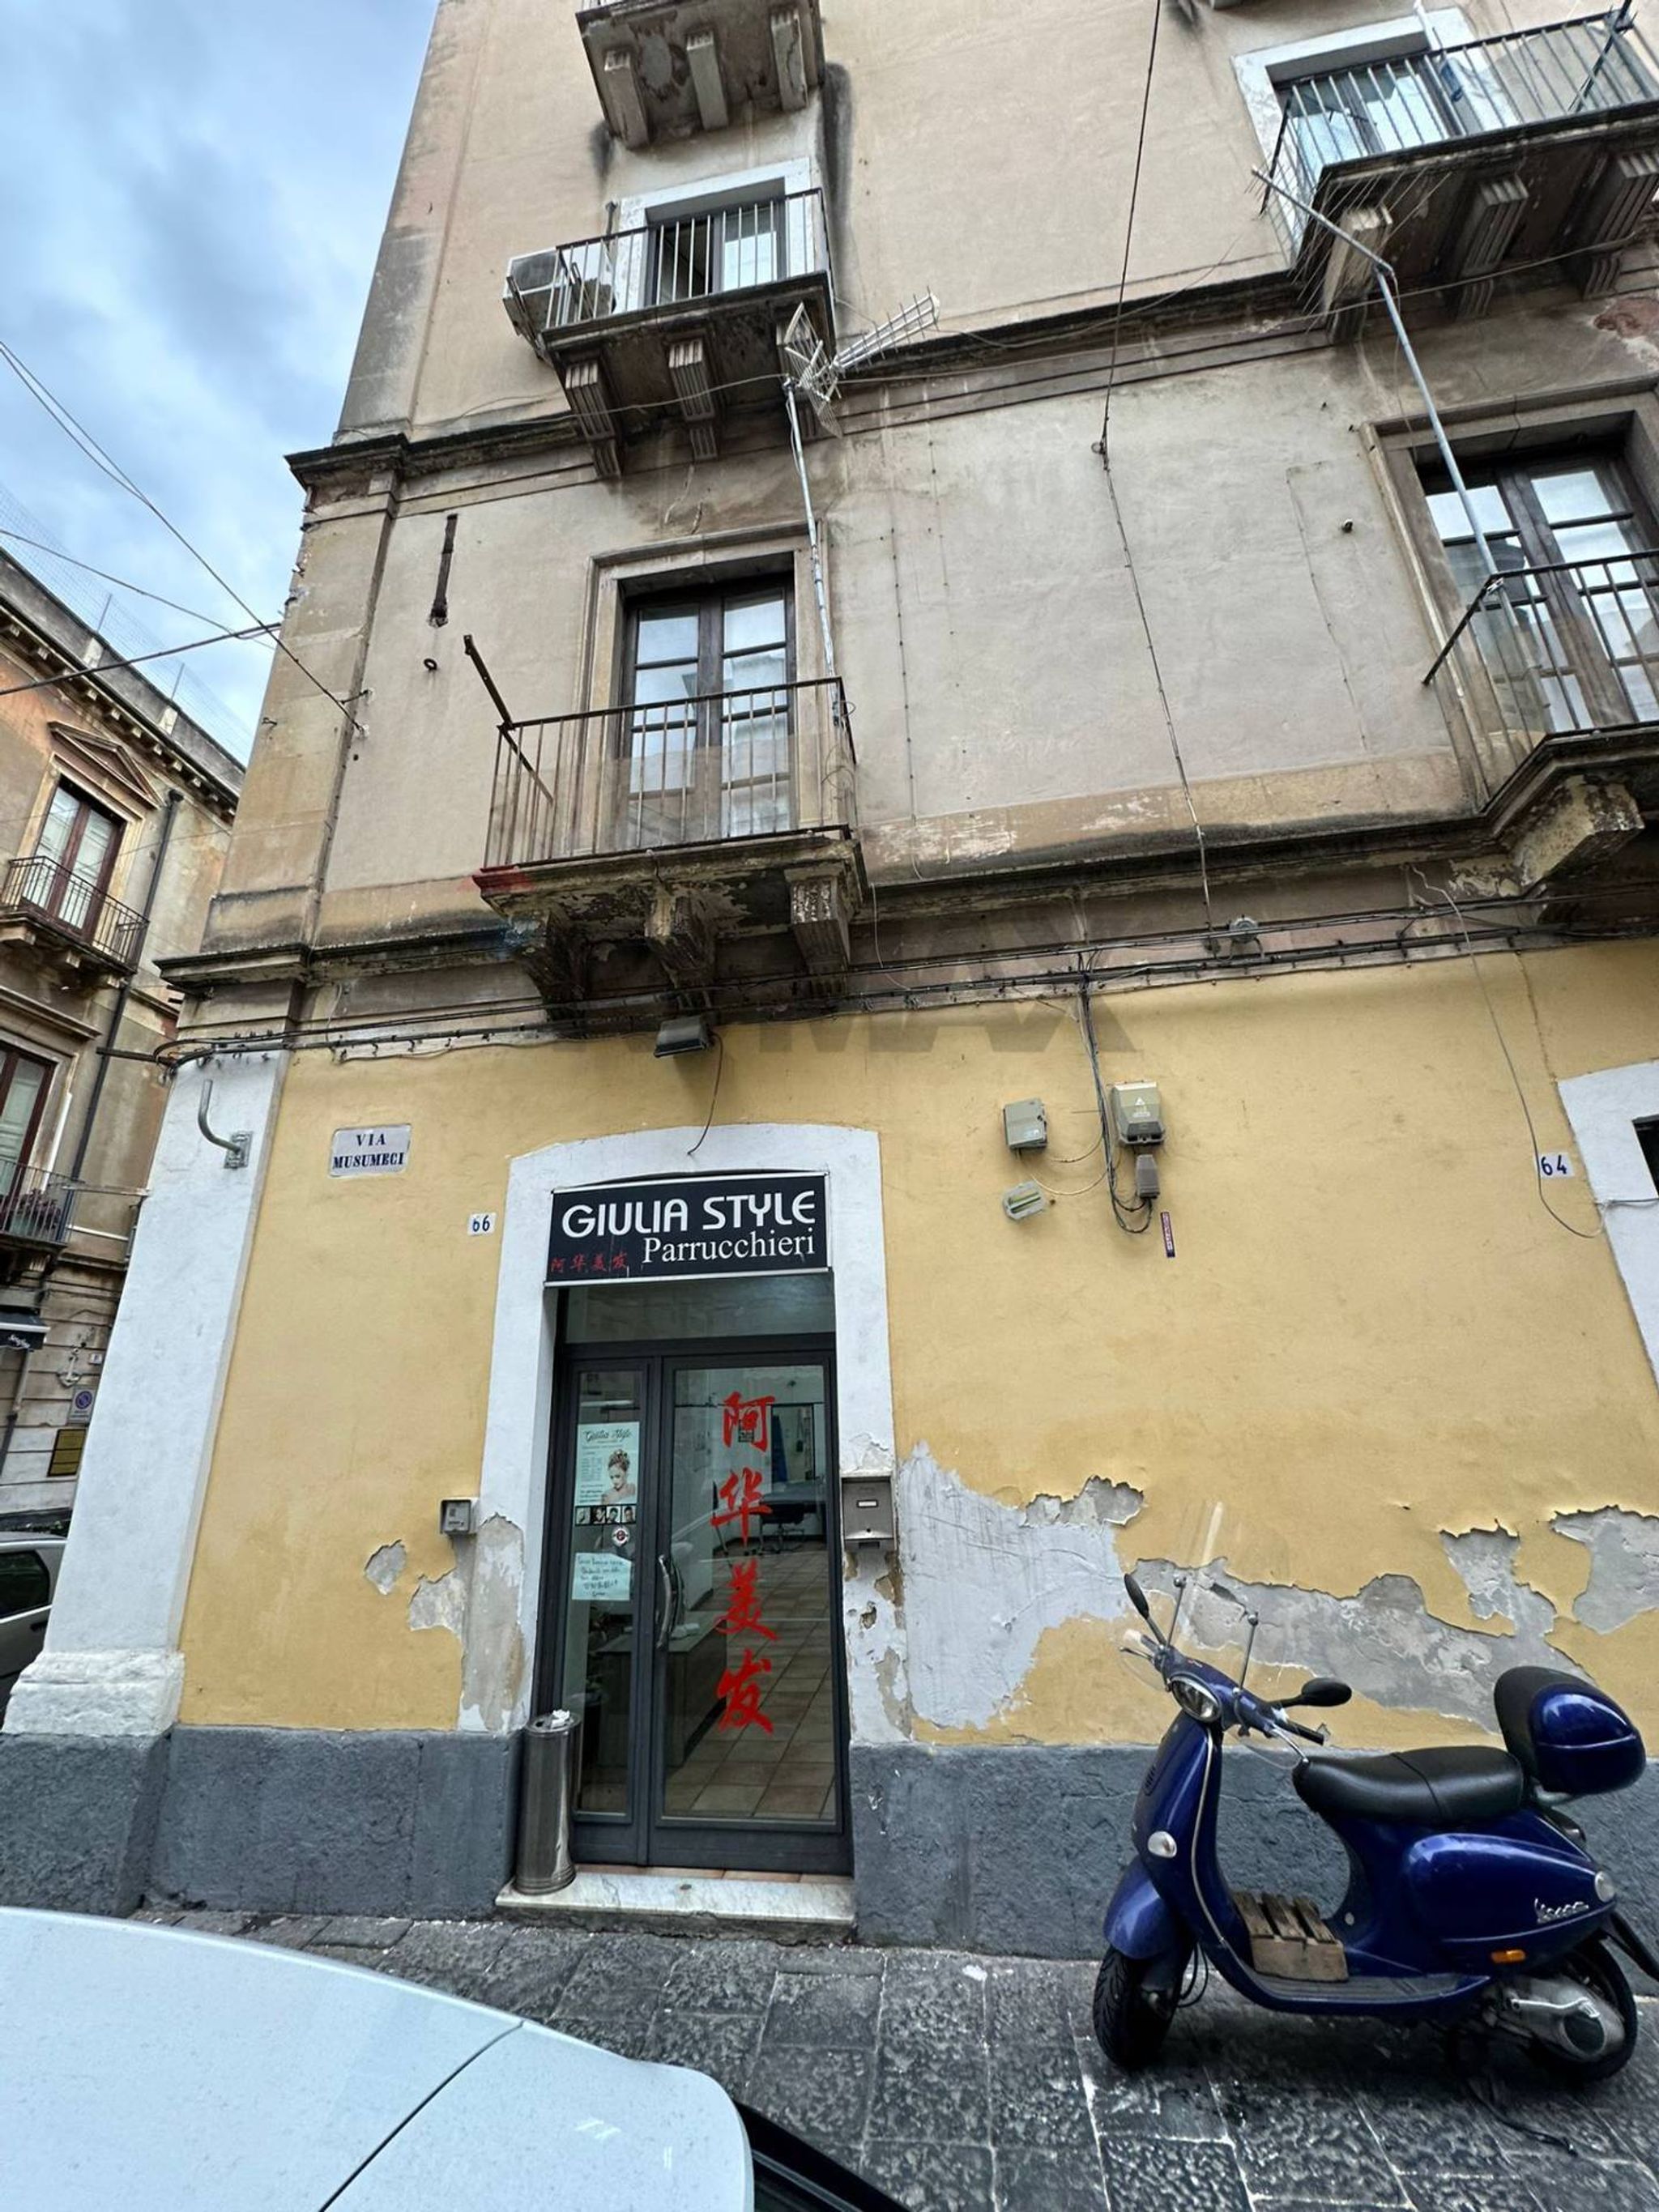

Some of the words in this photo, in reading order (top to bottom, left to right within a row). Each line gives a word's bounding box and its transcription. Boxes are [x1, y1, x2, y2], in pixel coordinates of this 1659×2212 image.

[356, 1133, 386, 1146] VIA
[332, 1152, 405, 1169] MUSUMECI
[1541, 1154, 1567, 1175] 64
[471, 1215, 491, 1232] 66
[561, 1199, 688, 1238] GIULIA
[702, 1191, 816, 1230] STYLE
[642, 1227, 815, 1264] Parrucchieri
[710, 1392, 780, 1735] 阿华美发
